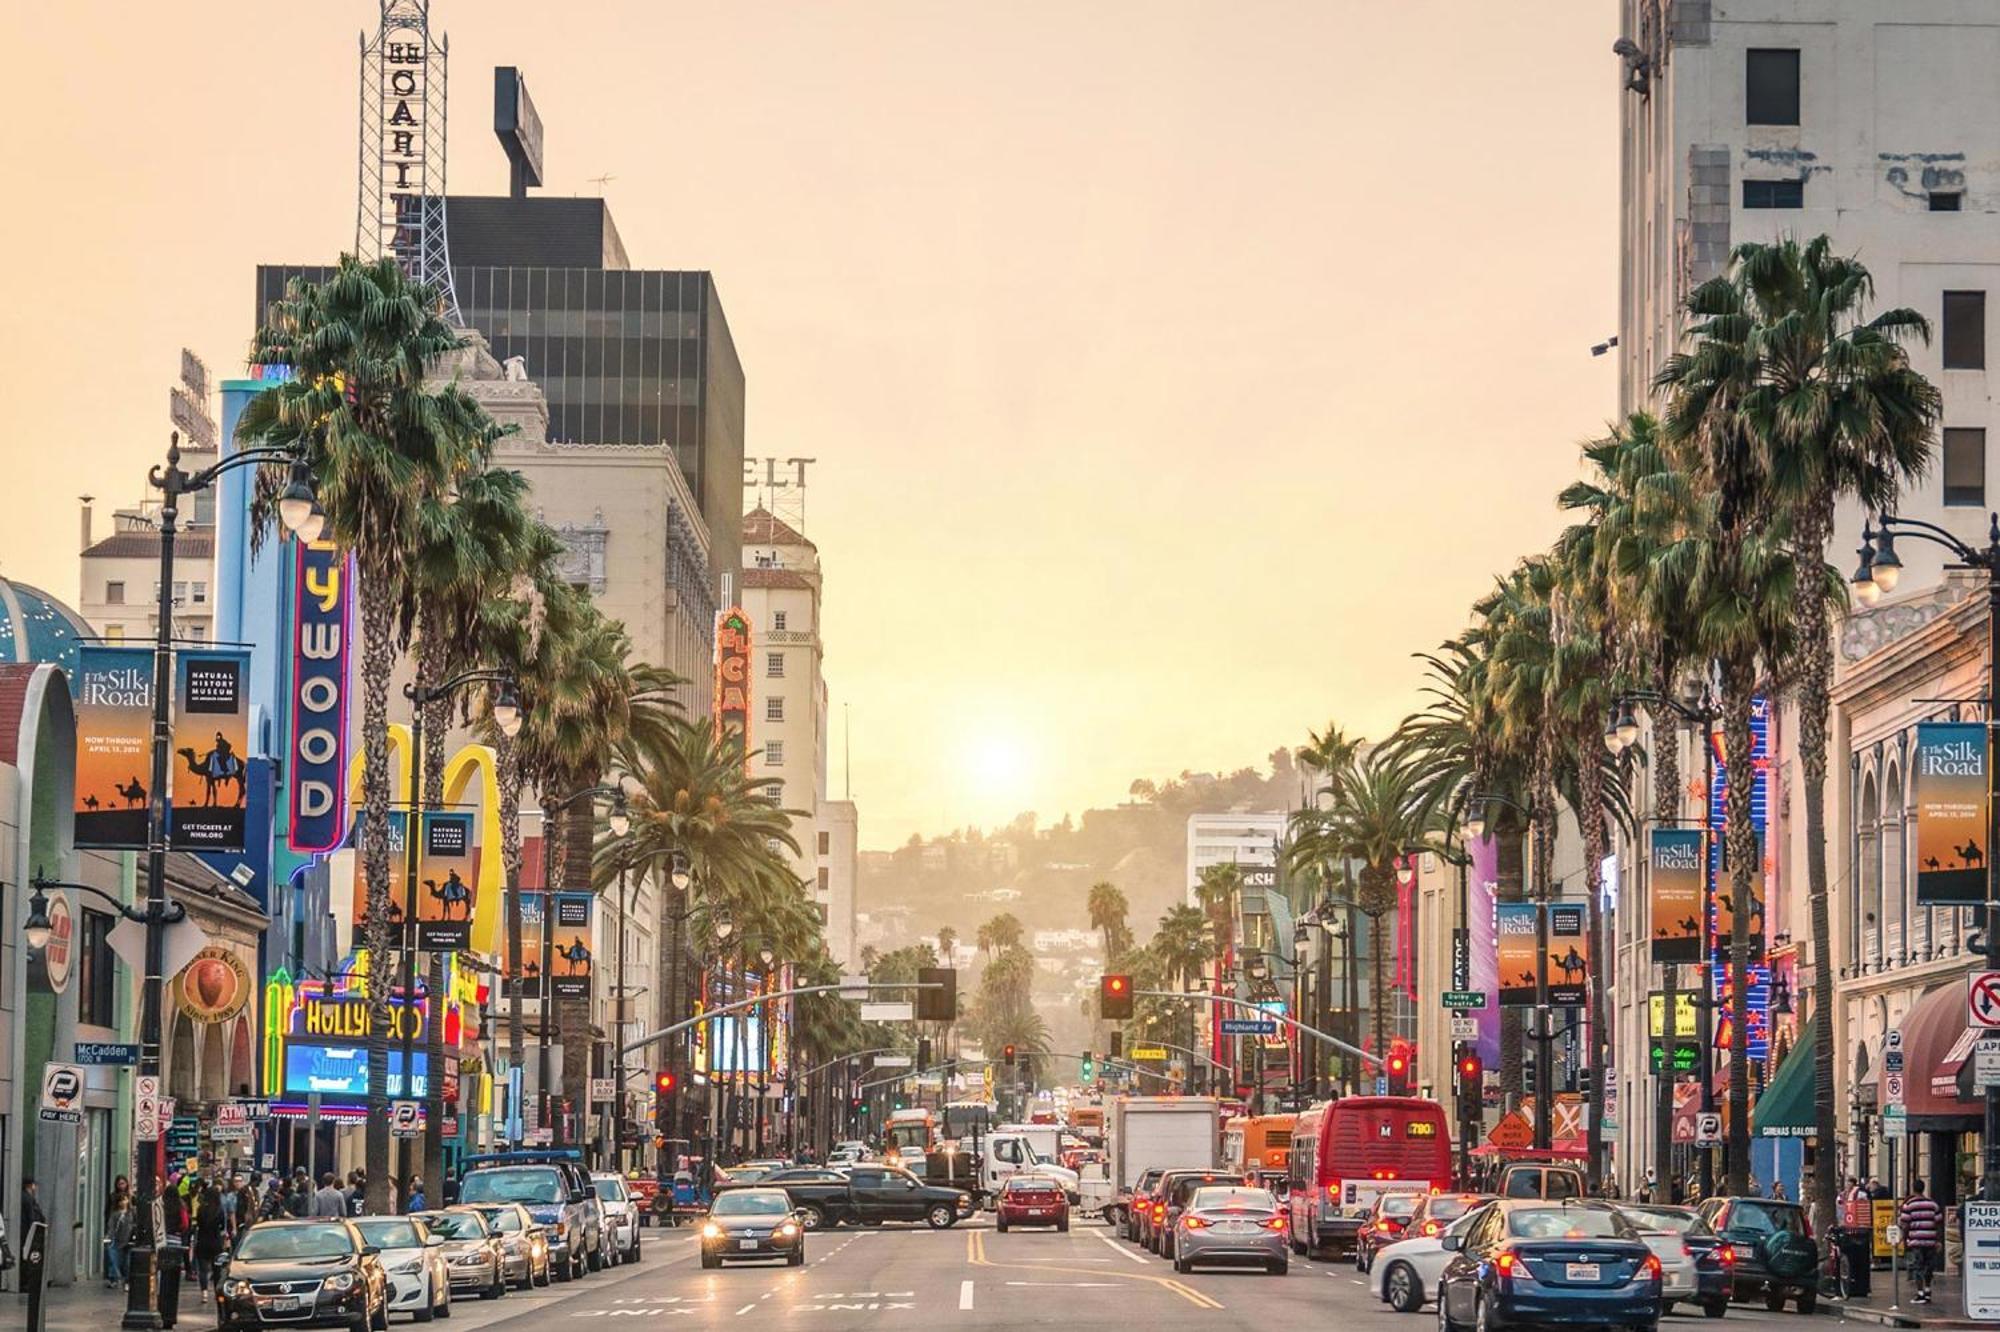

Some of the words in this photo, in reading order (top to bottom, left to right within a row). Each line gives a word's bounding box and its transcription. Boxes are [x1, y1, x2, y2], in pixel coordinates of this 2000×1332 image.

[92, 671, 110, 682] The
[108, 668, 144, 691] Silk
[192, 672, 233, 680] NATURAL
[92, 683, 149, 706] Road
[1943, 741, 1977, 761] Silk
[1929, 755, 1983, 776] Road
[1671, 844, 1696, 859] Silk
[1660, 853, 1699, 869] Road
[1512, 914, 1532, 926] Silk
[1504, 921, 1536, 934] Road
[1225, 1022, 1259, 1032] Highland
[78, 1044, 127, 1056] McCadden
[1976, 1042, 2000, 1051] LAP
[78, 1055, 93, 1063] 1700
[42, 1110, 56, 1119] PAY
[59, 1112, 79, 1122] HERE
[220, 1106, 245, 1119] ATM
[212, 1127, 250, 1135] INTERNET
[1380, 1126, 1391, 1137] M
[1411, 1123, 1431, 1134] 780
[354, 1202, 363, 1214] 5
[1968, 1218, 2000, 1228] PARK
